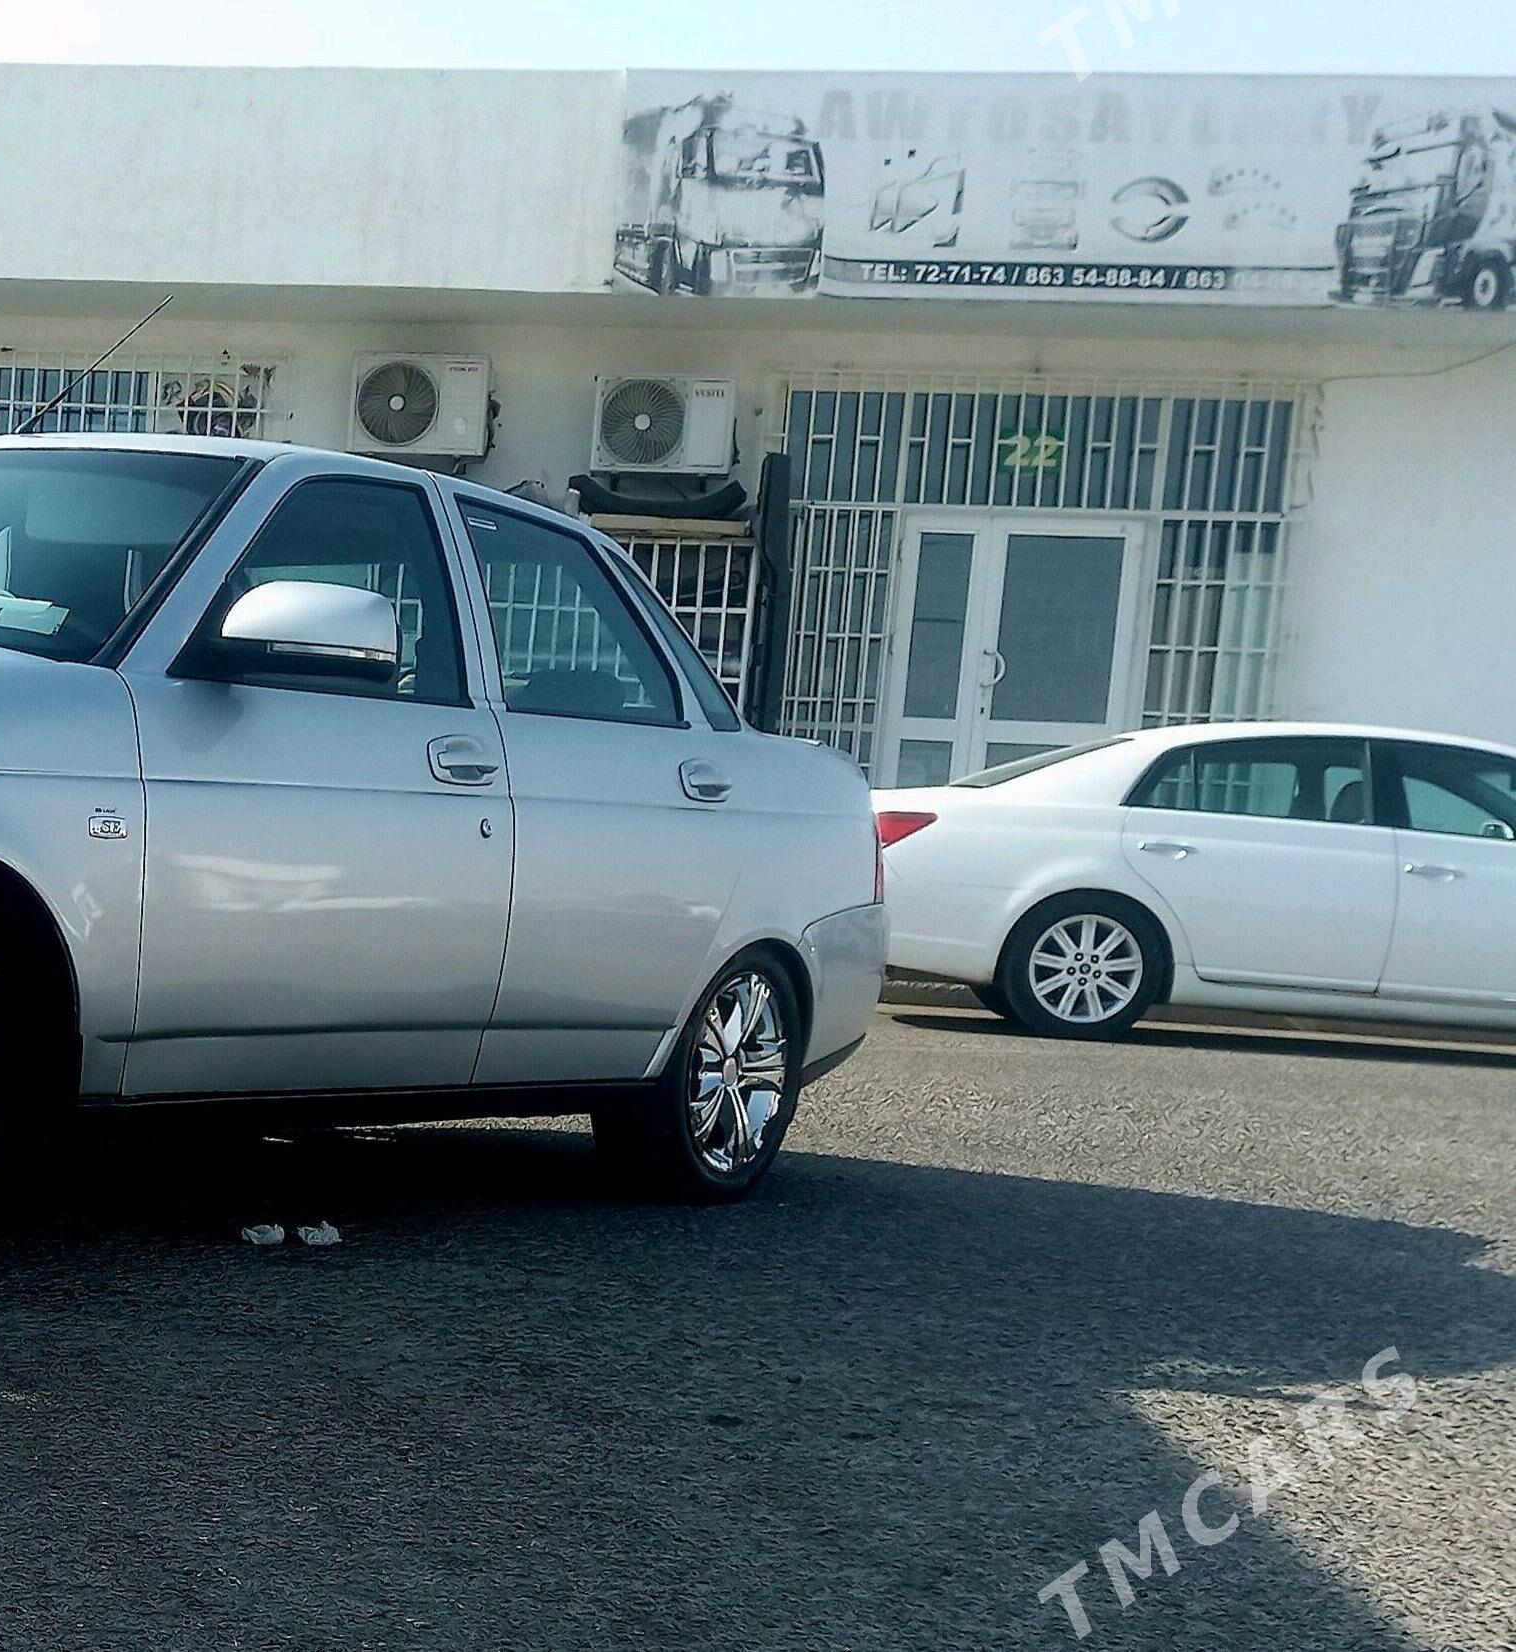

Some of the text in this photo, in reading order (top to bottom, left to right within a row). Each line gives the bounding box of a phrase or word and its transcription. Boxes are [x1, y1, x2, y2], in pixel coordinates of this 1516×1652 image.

[860, 263, 907, 283] TEL:
[914, 265, 1007, 284] 72-71-74
[1024, 266, 1065, 286] 863
[1071, 268, 1165, 288] 54-88-84
[1185, 269, 1225, 289] 863
[1003, 434, 1059, 468] 22
